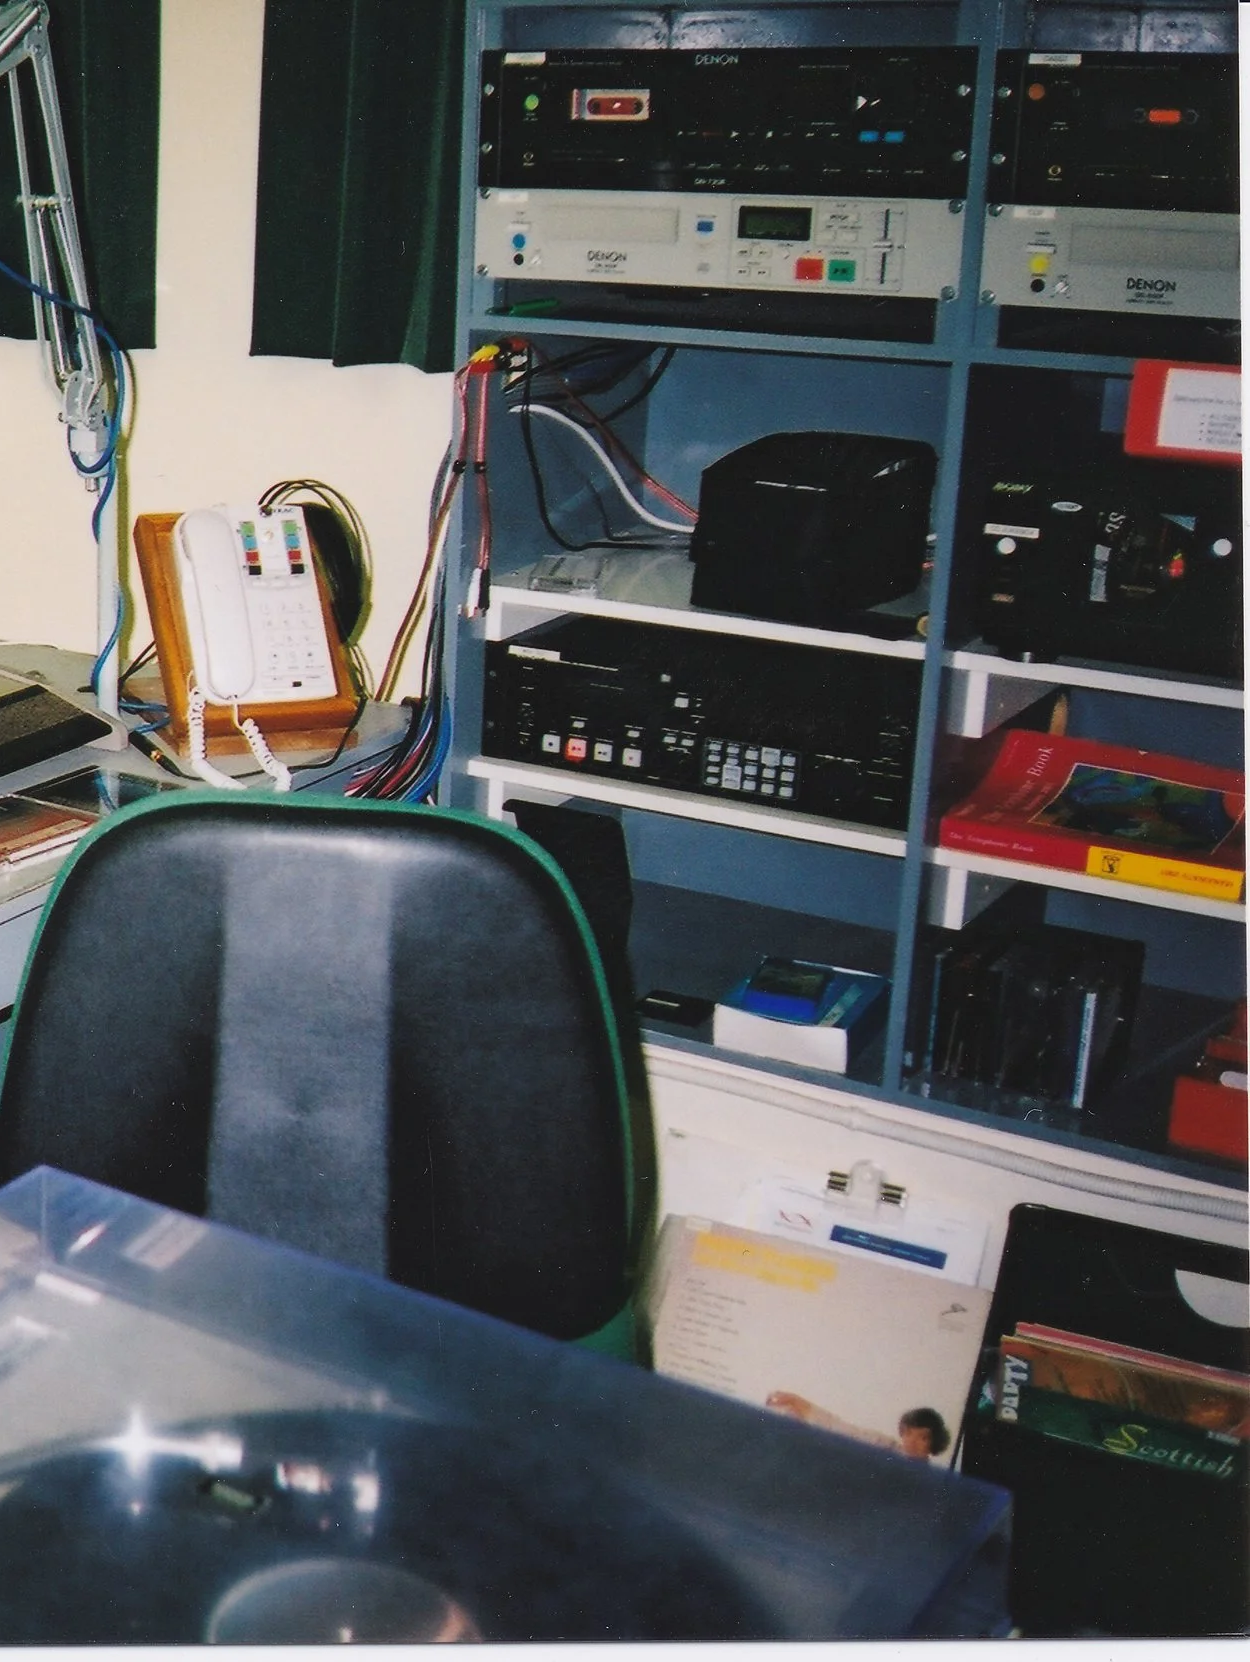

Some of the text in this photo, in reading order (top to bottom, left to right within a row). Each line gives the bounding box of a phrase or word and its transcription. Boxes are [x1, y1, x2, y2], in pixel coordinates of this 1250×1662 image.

[694, 53, 739, 66] DENON
[587, 249, 627, 262] DENON
[1126, 277, 1177, 292] DENON
[1026, 747, 1054, 777] Book
[1001, 1354, 1029, 1422] PARTY
[1102, 1424, 1234, 1478] Scottish
